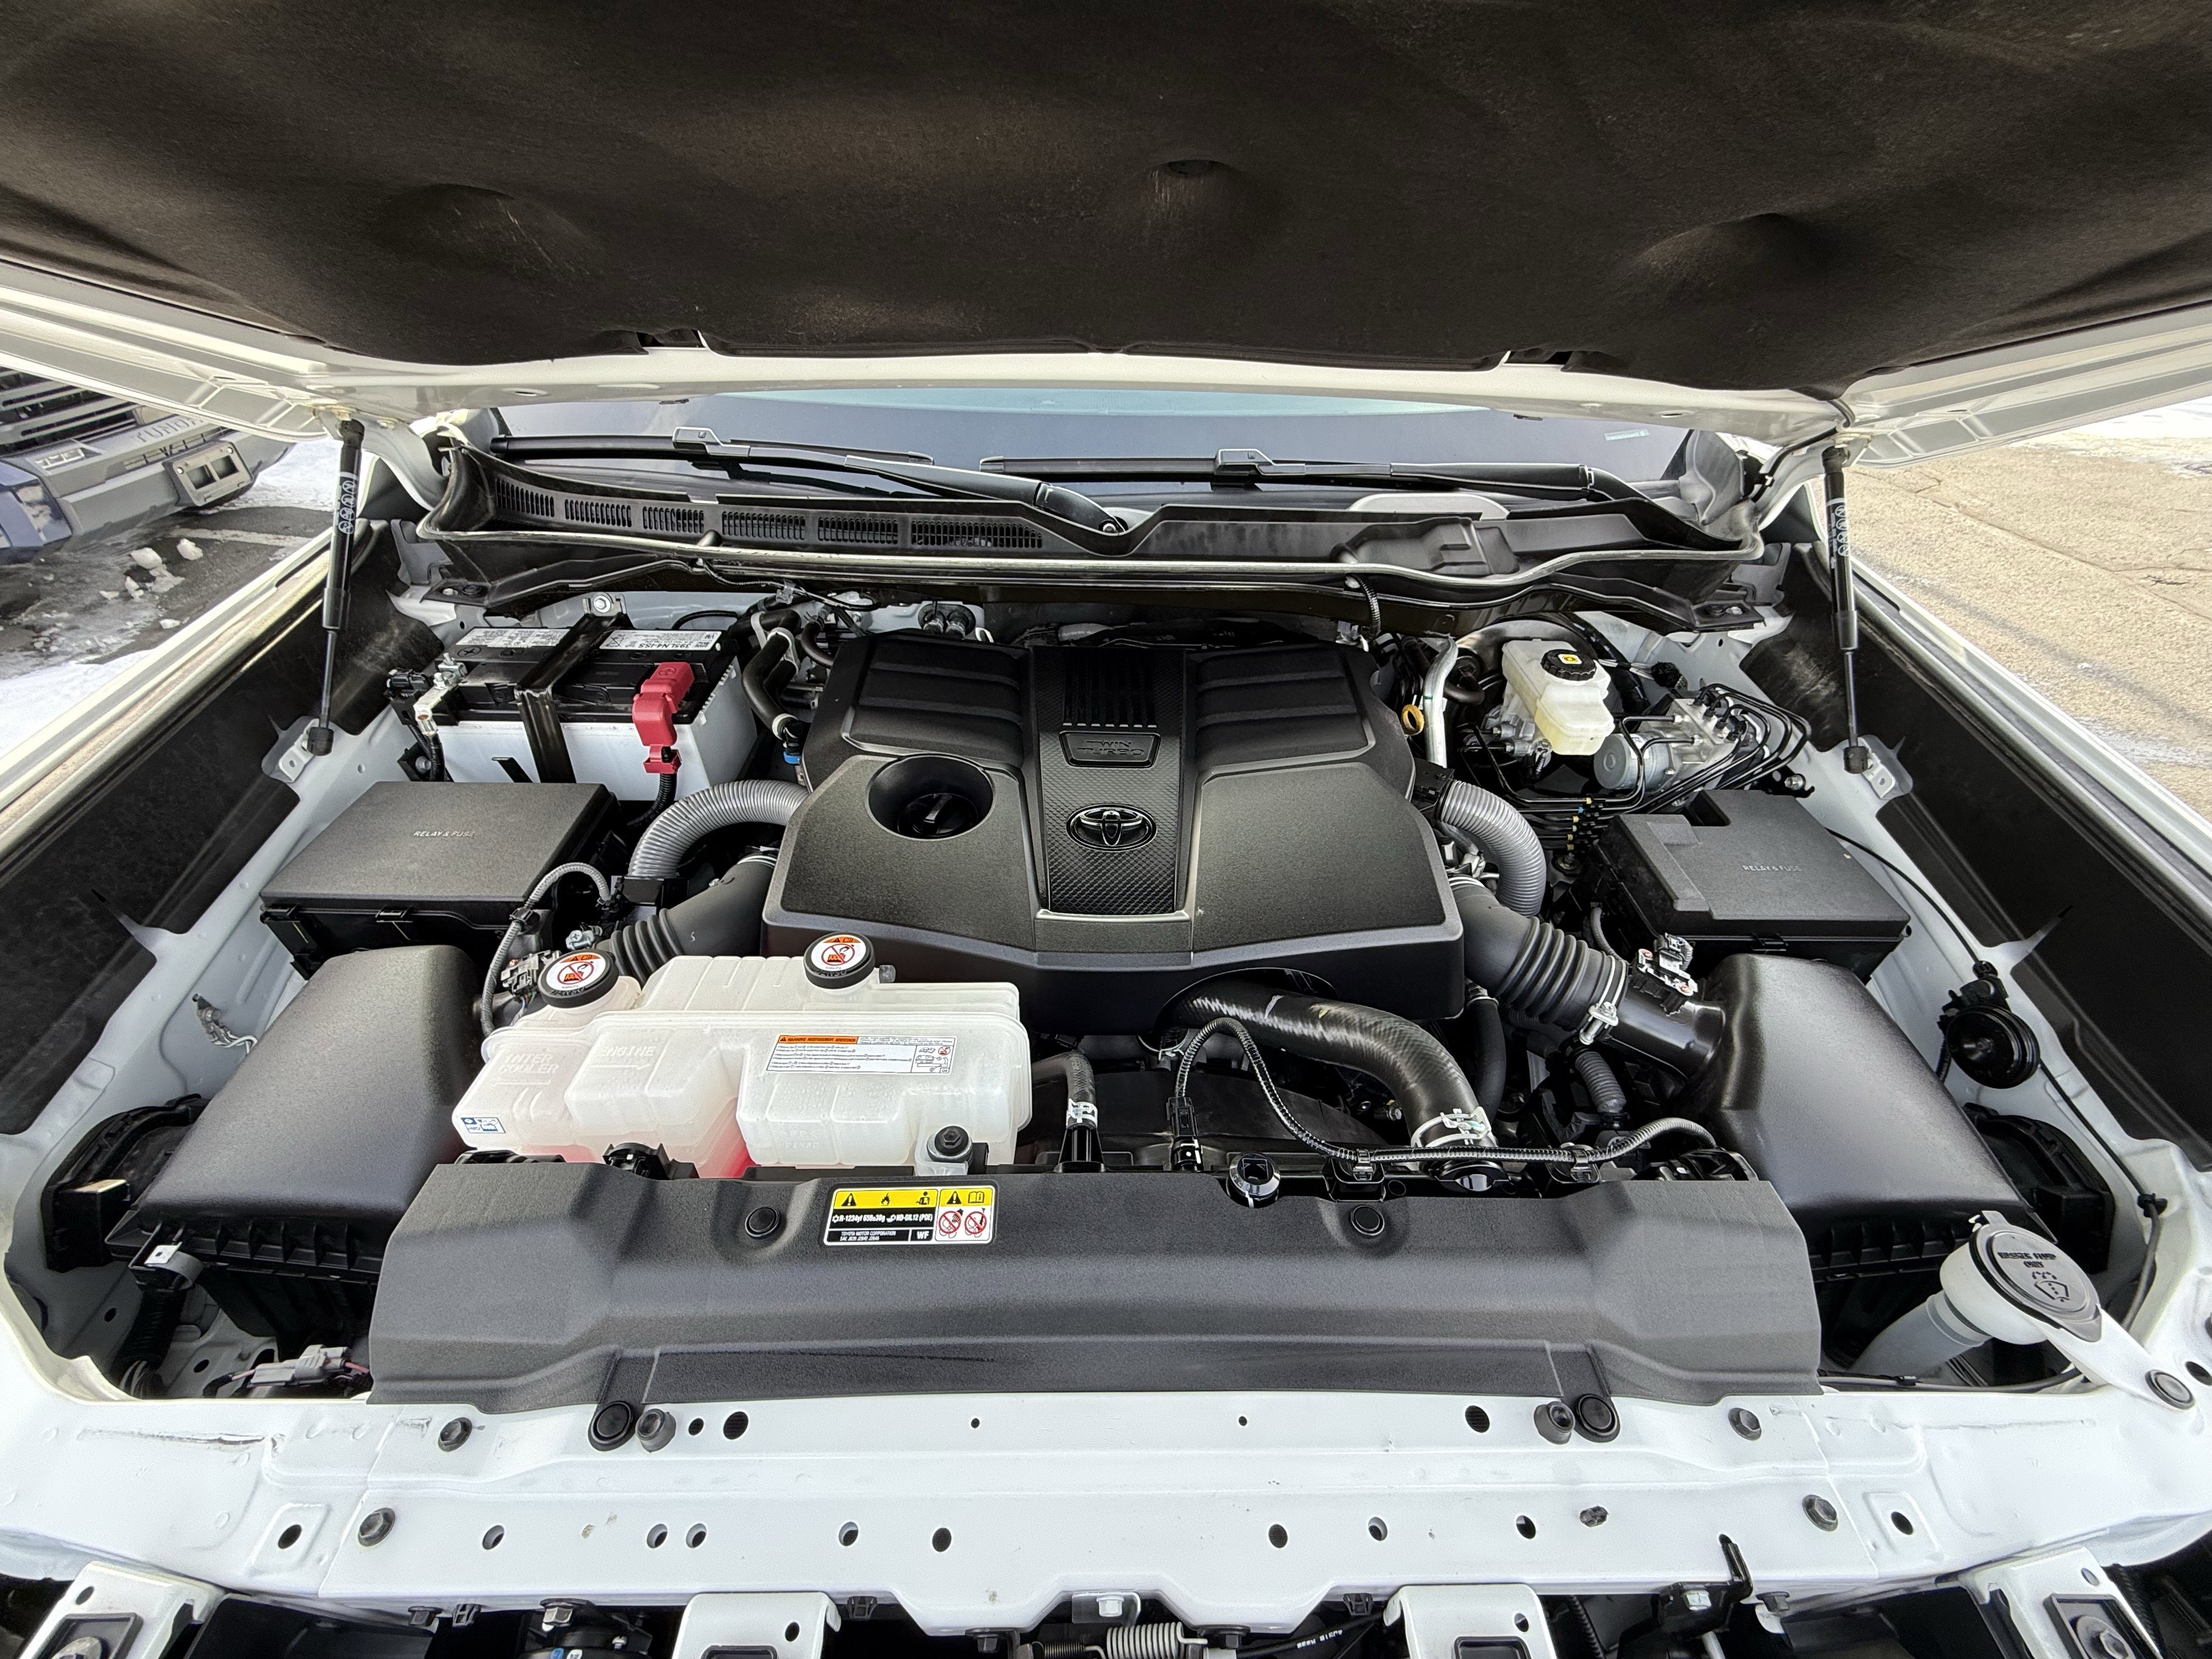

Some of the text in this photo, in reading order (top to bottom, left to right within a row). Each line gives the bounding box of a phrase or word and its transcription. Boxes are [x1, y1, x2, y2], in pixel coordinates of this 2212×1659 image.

[601, 1046, 657, 1057] ENGINE
[504, 1053, 553, 1064] INTER
[499, 1063, 559, 1074] COOLER
[917, 1231, 930, 1239] WF
